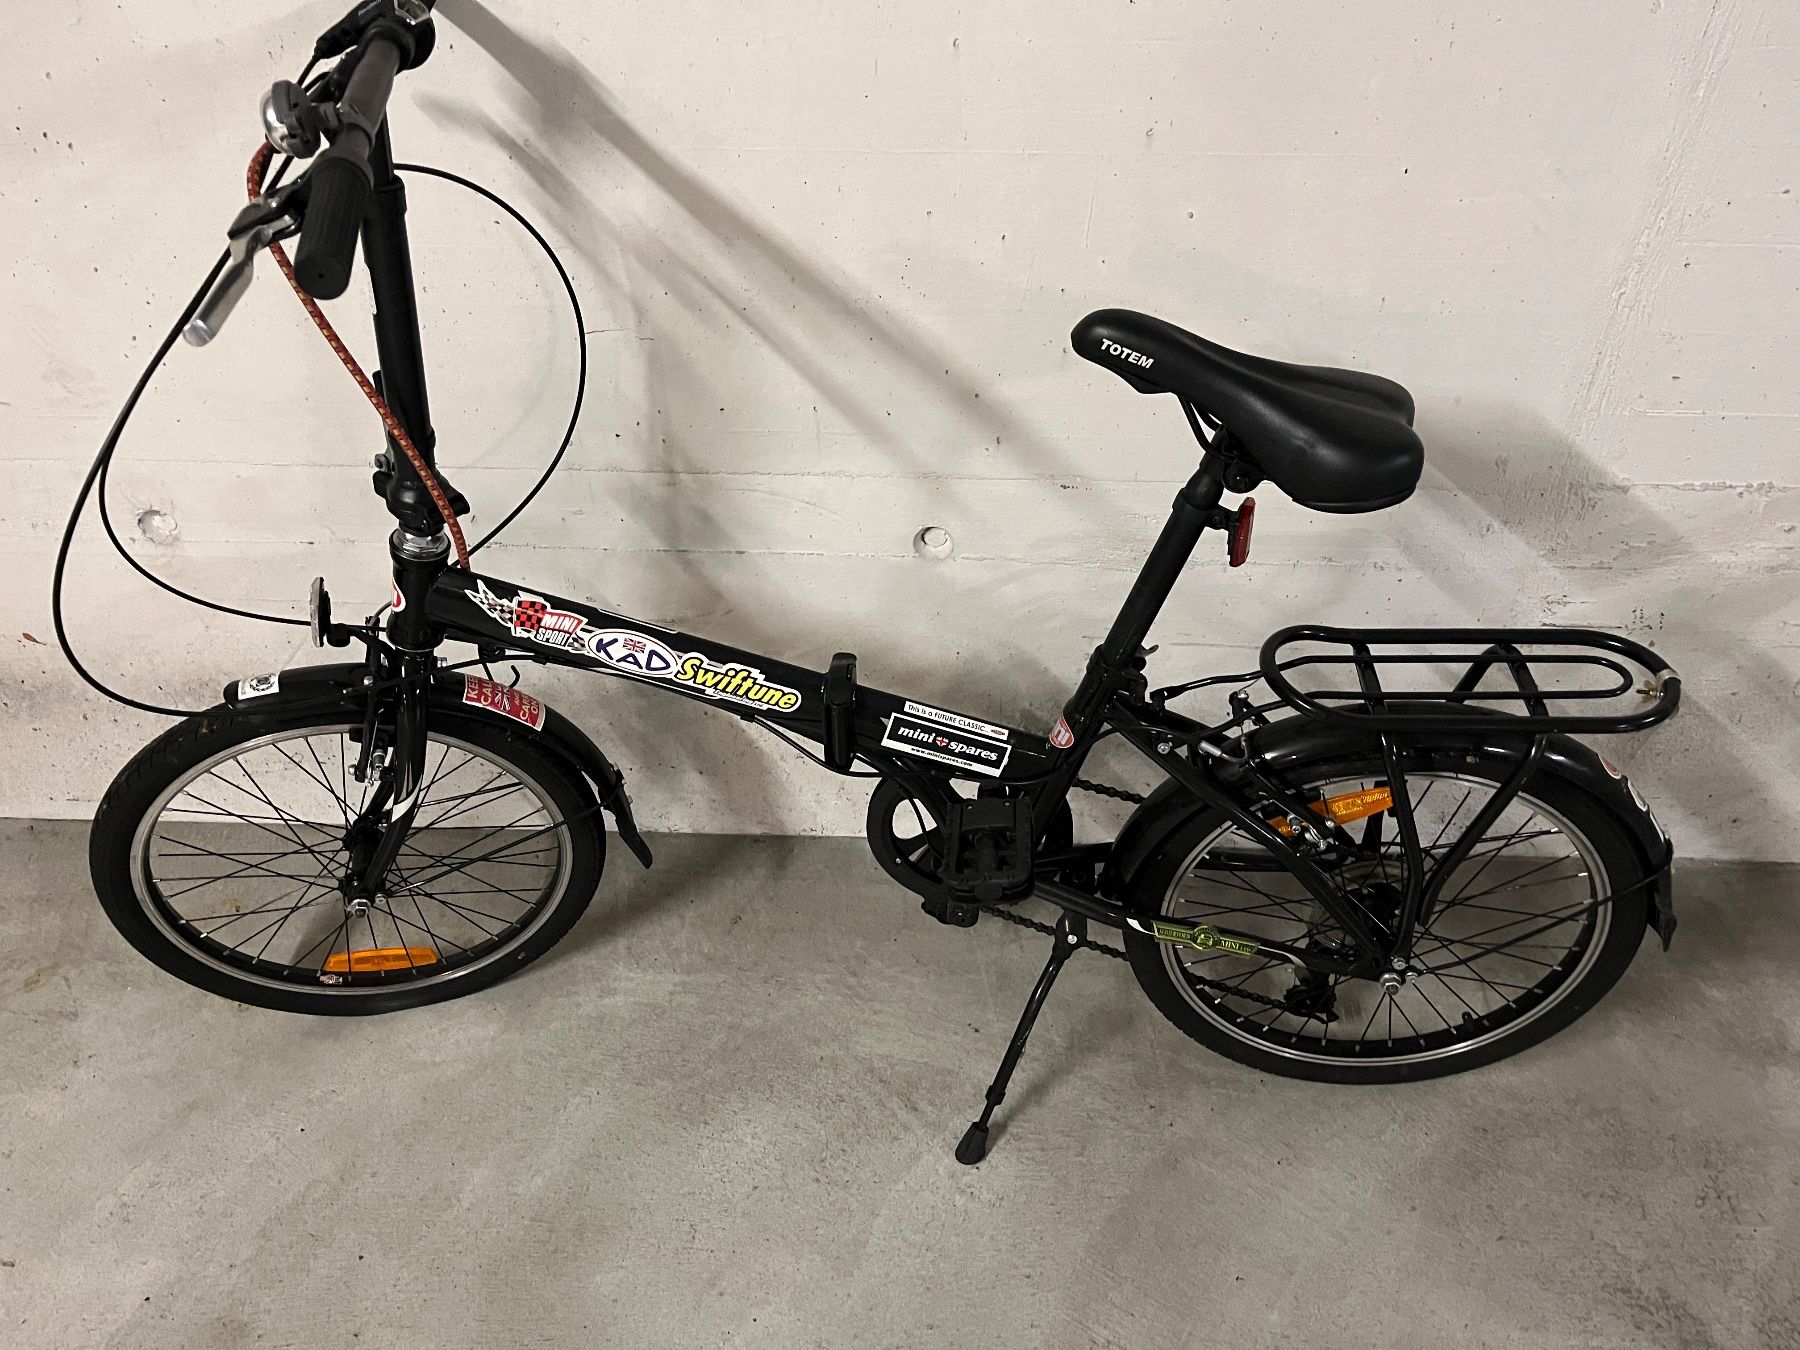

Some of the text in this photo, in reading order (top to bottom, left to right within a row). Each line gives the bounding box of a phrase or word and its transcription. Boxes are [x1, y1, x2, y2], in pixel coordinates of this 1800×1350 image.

[1101, 338, 1154, 369] TOTEM
[540, 613, 578, 633] MINI
[536, 628, 573, 645] SPORT
[595, 637, 671, 672] KAD
[467, 675, 479, 699] KEE
[480, 680, 493, 706] CAL
[675, 657, 798, 709] Swiftune
[908, 704, 920, 713] This
[934, 713, 957, 724] FUTURE
[897, 726, 998, 761] mini spares
